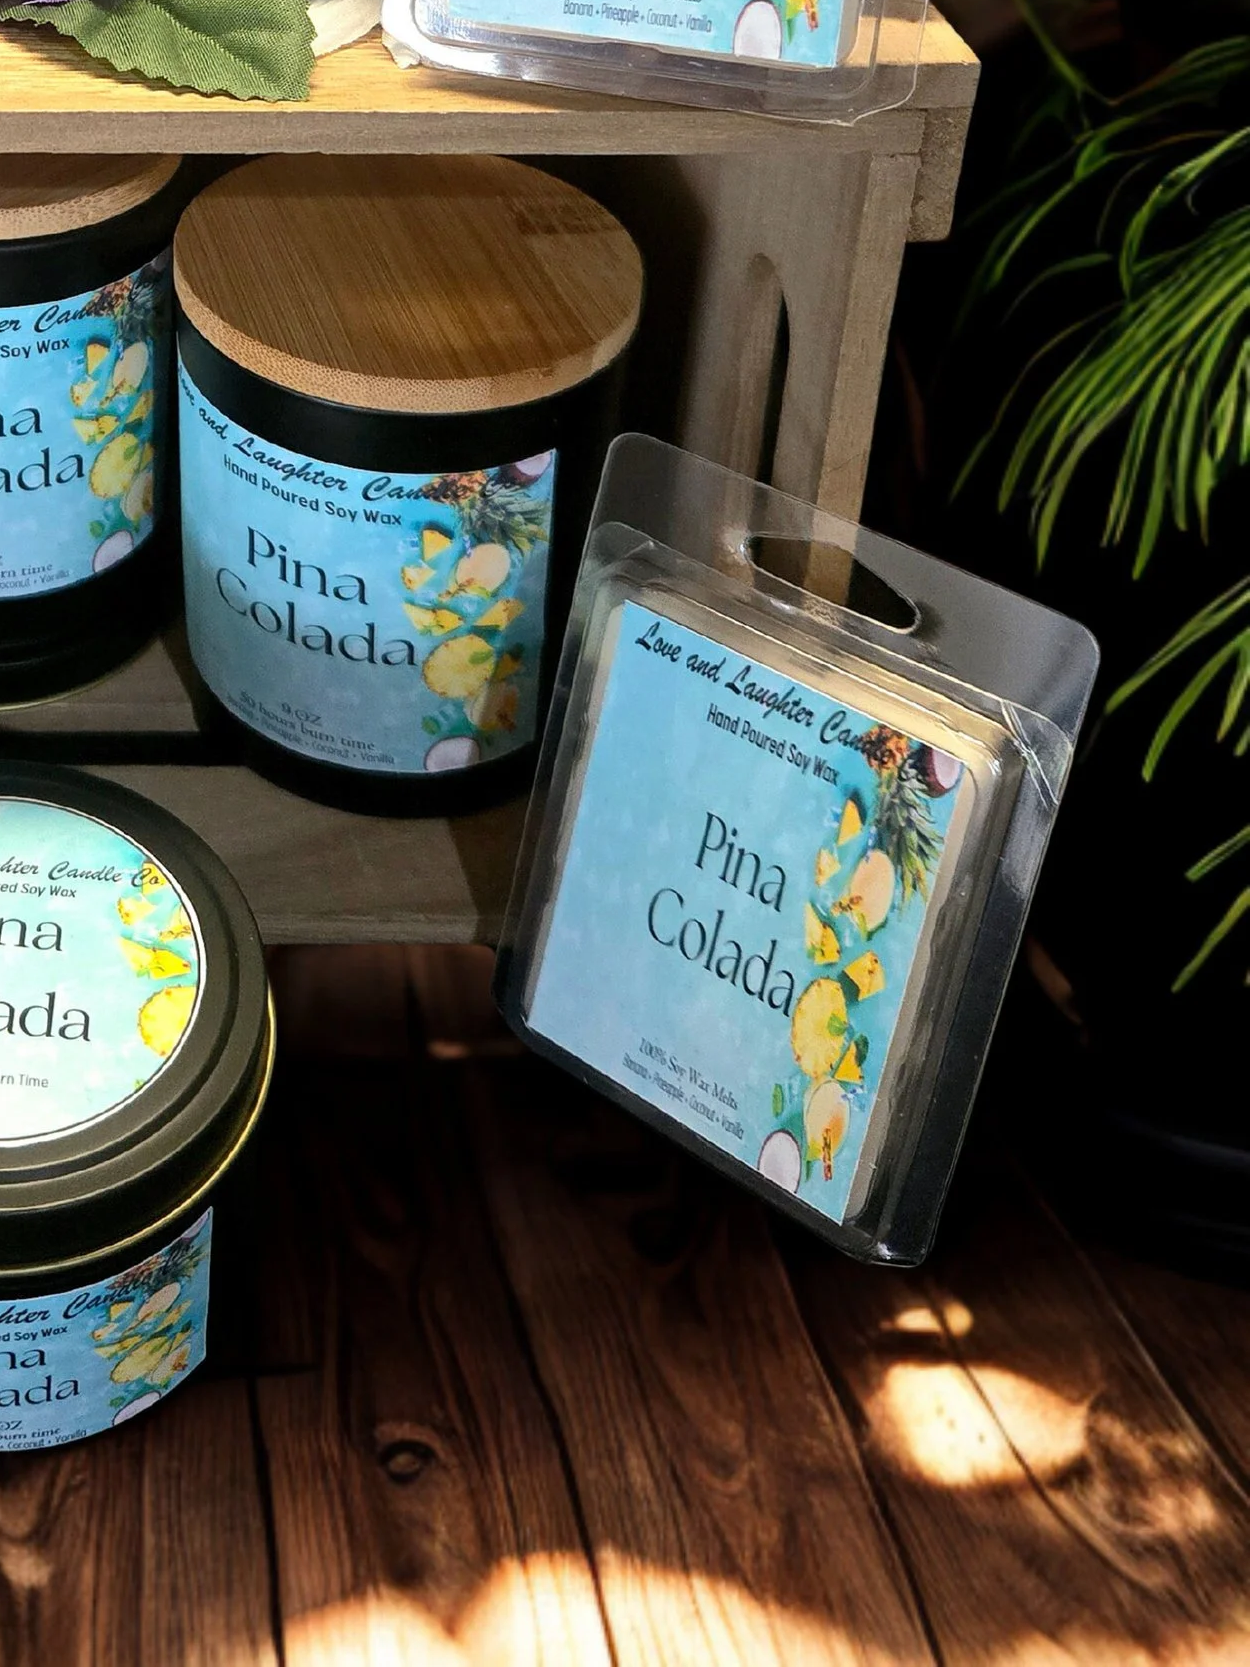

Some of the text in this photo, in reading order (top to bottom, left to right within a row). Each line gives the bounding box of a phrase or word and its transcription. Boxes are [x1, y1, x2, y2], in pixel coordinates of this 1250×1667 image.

[600, 3, 639, 25] Pineapple
[646, 9, 677, 29] Coconut
[686, 13, 712, 33] Vanilla
[0, 344, 31, 360] Soy
[37, 337, 71, 353] Wax
[224, 454, 402, 526] Hand Poured Soy Wax
[233, 437, 348, 492] Laughter
[247, 526, 369, 606] Pina
[216, 568, 418, 667] Colada
[636, 620, 814, 729] Love and Laughter
[707, 702, 839, 787] Hand Poured Soy Wax
[20, 882, 45, 897] Soy
[49, 884, 76, 898] Wax
[48, 861, 122, 883] Candle
[694, 811, 788, 912] Pina
[648, 888, 795, 1018] Colada
[19, 1074, 49, 1088] Time
[14, 1330, 39, 1343] Soy
[42, 1325, 68, 1337] Wax
